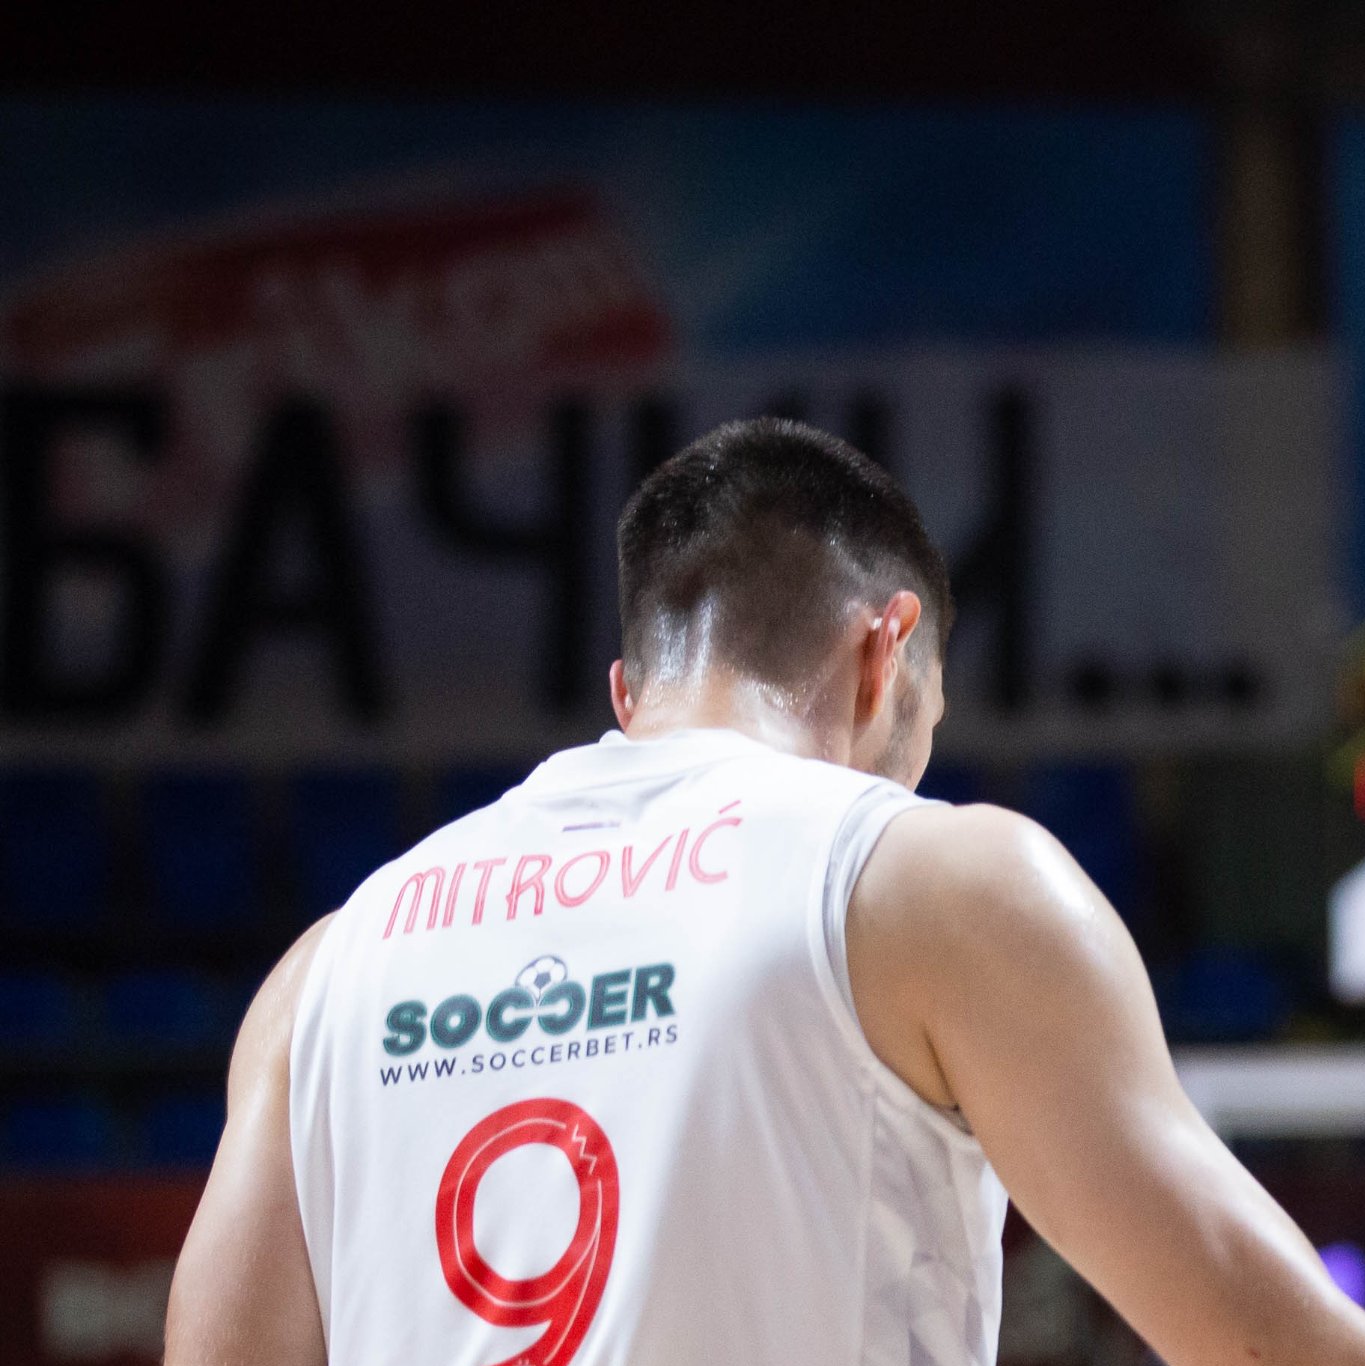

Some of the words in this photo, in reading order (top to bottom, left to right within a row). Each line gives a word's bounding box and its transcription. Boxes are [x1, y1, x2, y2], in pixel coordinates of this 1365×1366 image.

[382, 799, 743, 940] MITROVIĆ
[379, 1024, 679, 1087] WWW.SOCCERBET.RS
[382, 961, 677, 1058] SOCCER
